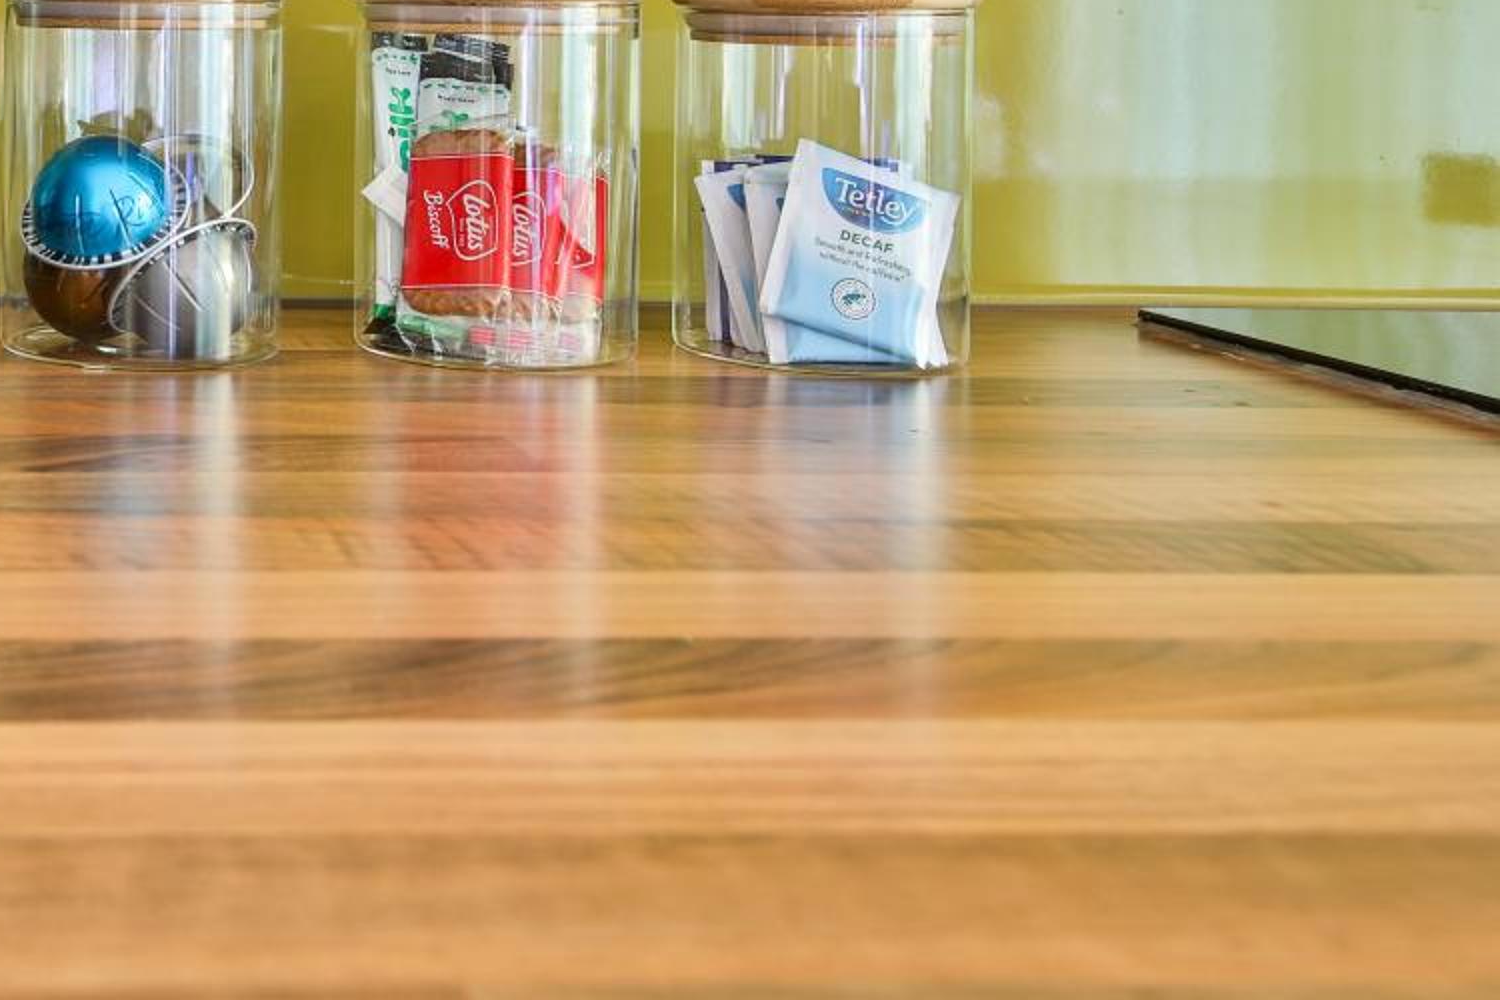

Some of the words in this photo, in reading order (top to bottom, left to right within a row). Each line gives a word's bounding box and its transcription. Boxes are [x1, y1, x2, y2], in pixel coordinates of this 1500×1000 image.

[423, 189, 450, 249] Biscoff
[835, 177, 916, 226] Tetley
[839, 229, 895, 254] DECAF
